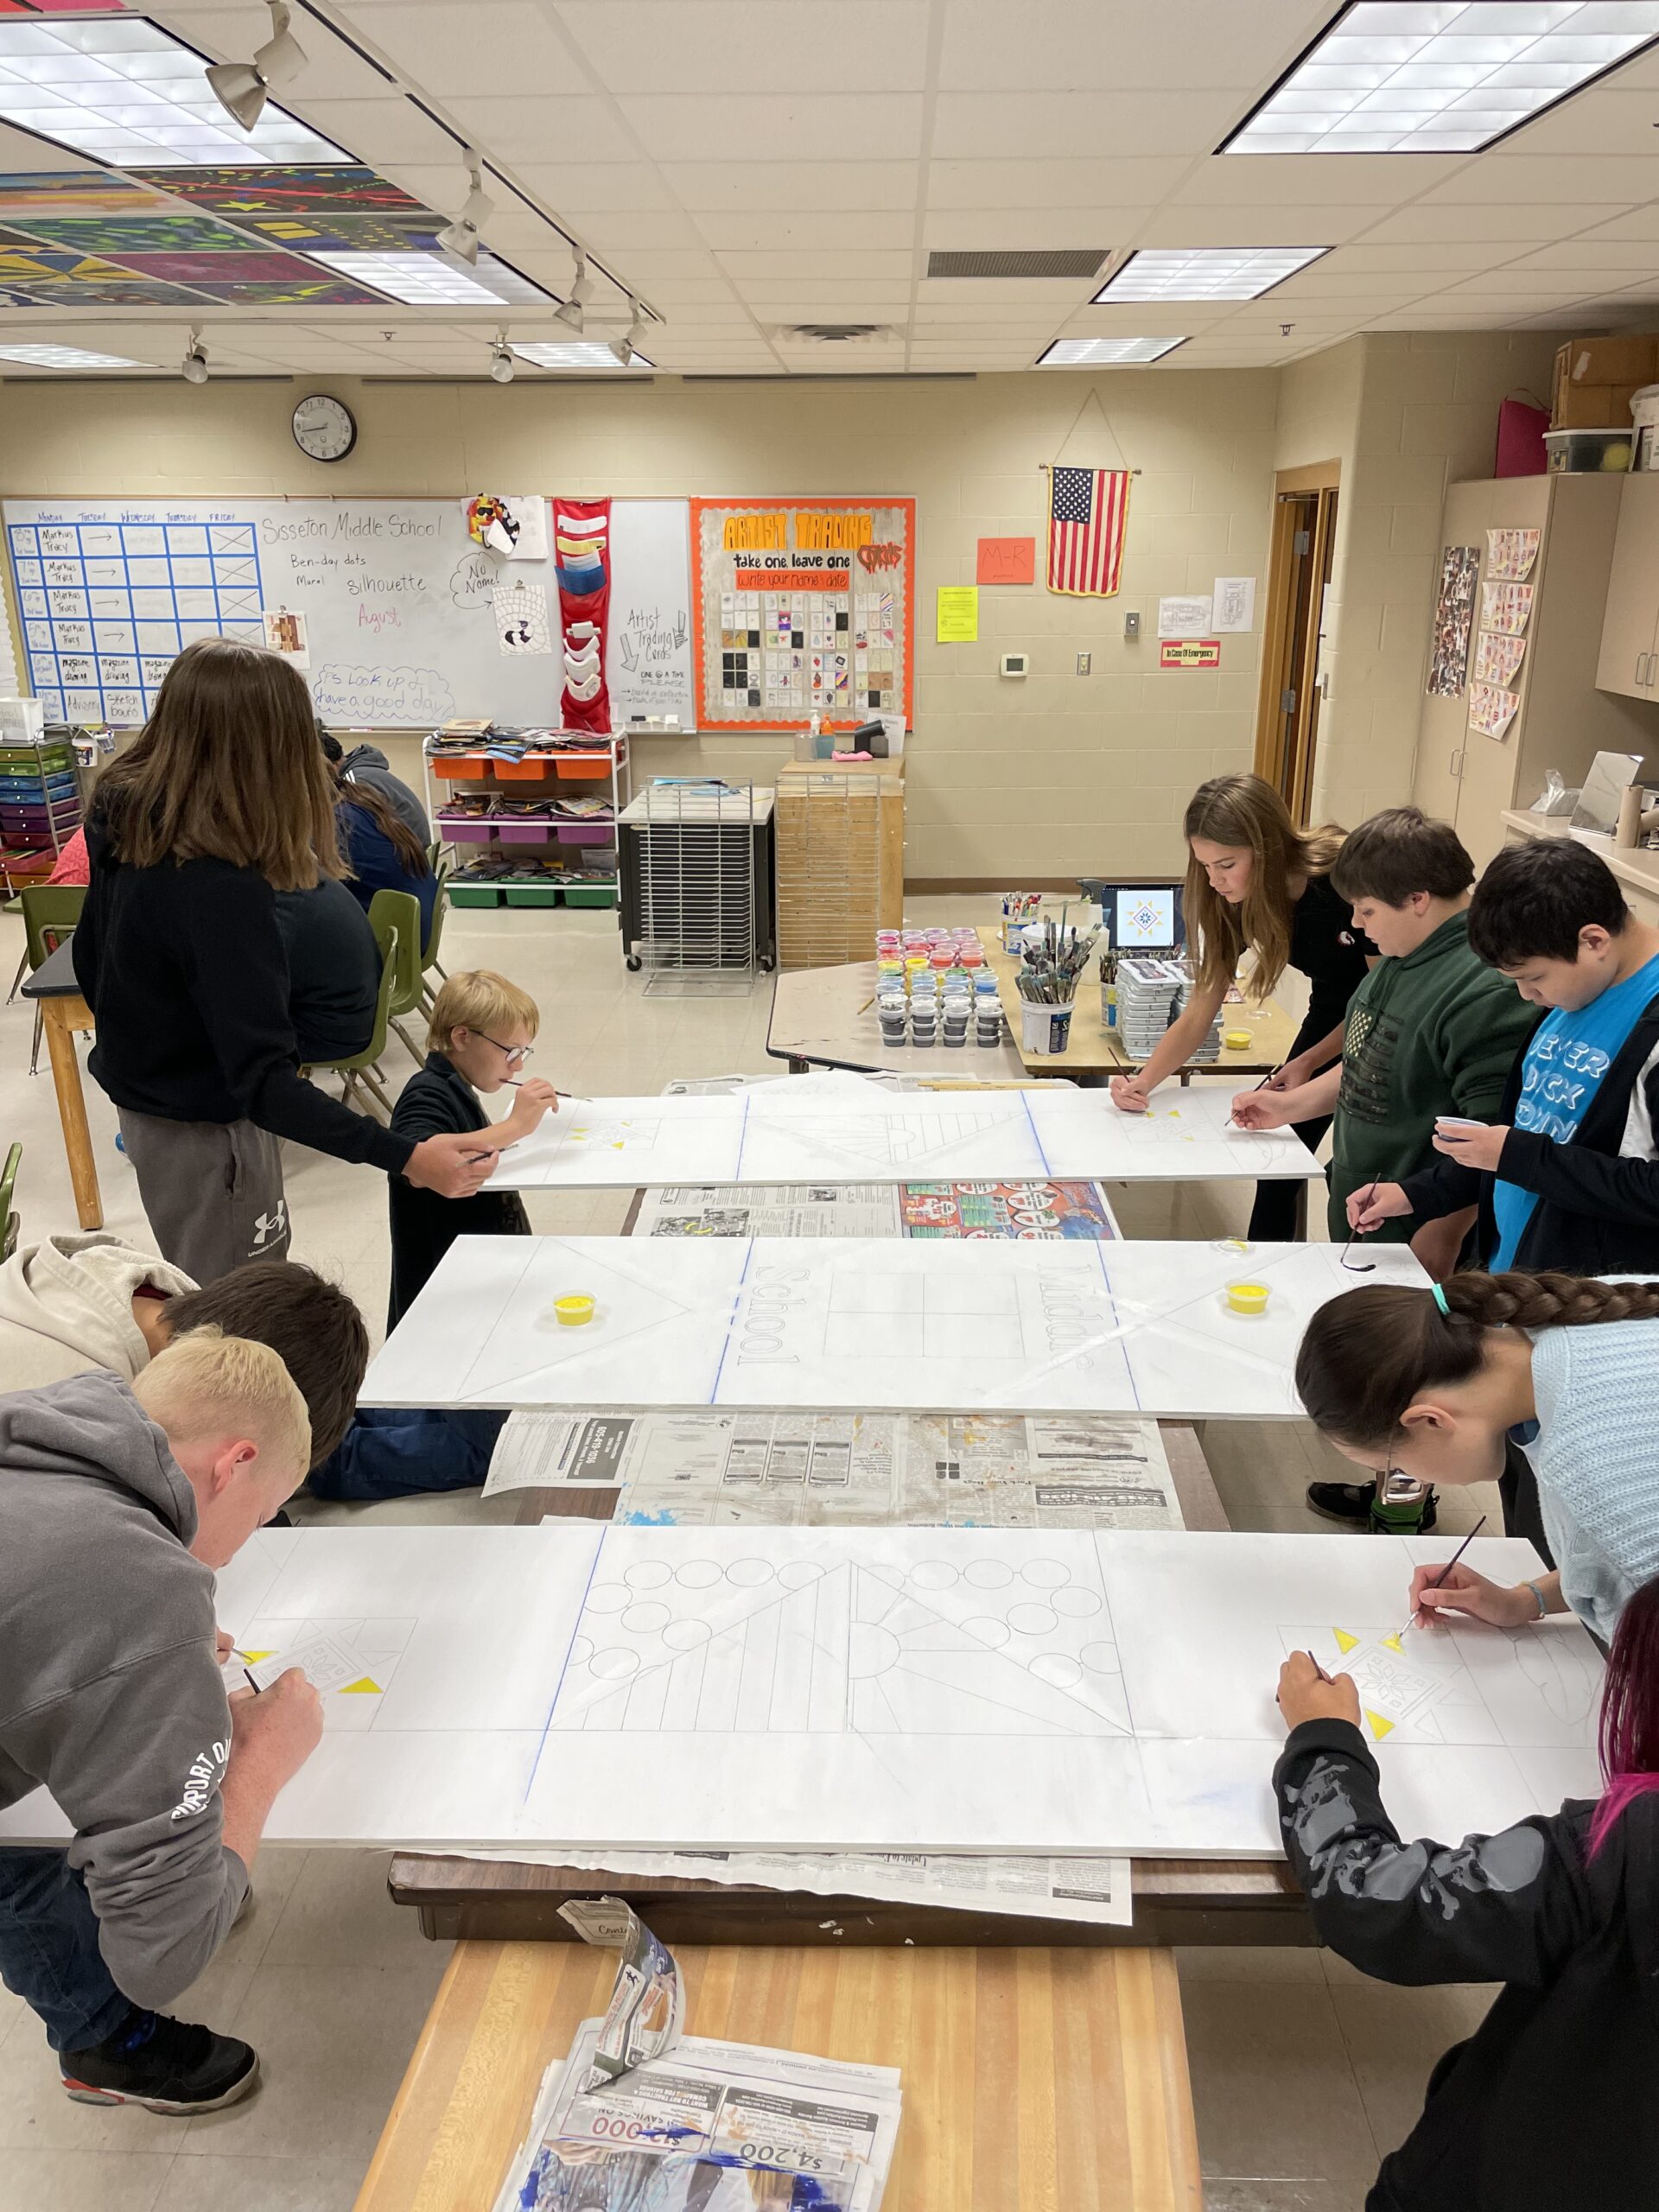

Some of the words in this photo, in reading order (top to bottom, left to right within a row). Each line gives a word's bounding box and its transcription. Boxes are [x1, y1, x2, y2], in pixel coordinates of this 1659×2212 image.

[209, 513, 235, 522] FRIDAY
[262, 518, 328, 544] Sisseton
[332, 512, 384, 542] Middle
[390, 514, 442, 539] School
[724, 514, 787, 550] ARTIST
[795, 514, 873, 550] TRADING
[42, 529, 73, 540] Markus
[43, 542, 68, 553] Tracy
[291, 553, 339, 569] Ben-day
[344, 554, 366, 565] dots
[734, 553, 761, 568] take
[791, 553, 823, 568] leave
[827, 556, 850, 568] one
[982, 545, 1027, 567] M-R
[47, 561, 77, 572] Markus
[52, 572, 73, 584] Tracy
[296, 575, 324, 586] Mural
[346, 573, 427, 595] silhouette
[465, 570, 500, 594] Name!
[768, 573, 791, 590] your
[791, 574, 819, 587] name
[826, 573, 847, 587] date
[53, 590, 81, 602] Markus
[56, 601, 78, 613] Tracy
[626, 607, 661, 630] Artist
[59, 624, 86, 633] Markus
[62, 635, 80, 646] Tracy
[633, 629, 672, 651] Trading
[645, 645, 671, 662] Cards
[1166, 649, 1172, 658] In
[1172, 649, 1182, 658] Case
[1182, 649, 1189, 658] Of
[1188, 649, 1214, 658] Emergency
[62, 658, 91, 672] magazine
[101, 658, 130, 671] magazine
[147, 672, 168, 683] drawin
[640, 678, 685, 688] PLEASE
[106, 694, 139, 705] Sketch
[317, 688, 346, 708] have
[349, 694, 359, 705] a
[363, 694, 405, 716] good
[412, 693, 443, 715] day
[737, 1266, 810, 1367] School
[585, 1426, 607, 1464] 605-419-1036
[892, 1853, 899, 1863] to
[899, 1853, 927, 1867] Update
[640, 2091, 669, 2102] TRACTORS
[669, 2096, 681, 2105] BUY
[693, 2099, 709, 2108] WANT
[740, 2143, 823, 2170] $4,200
